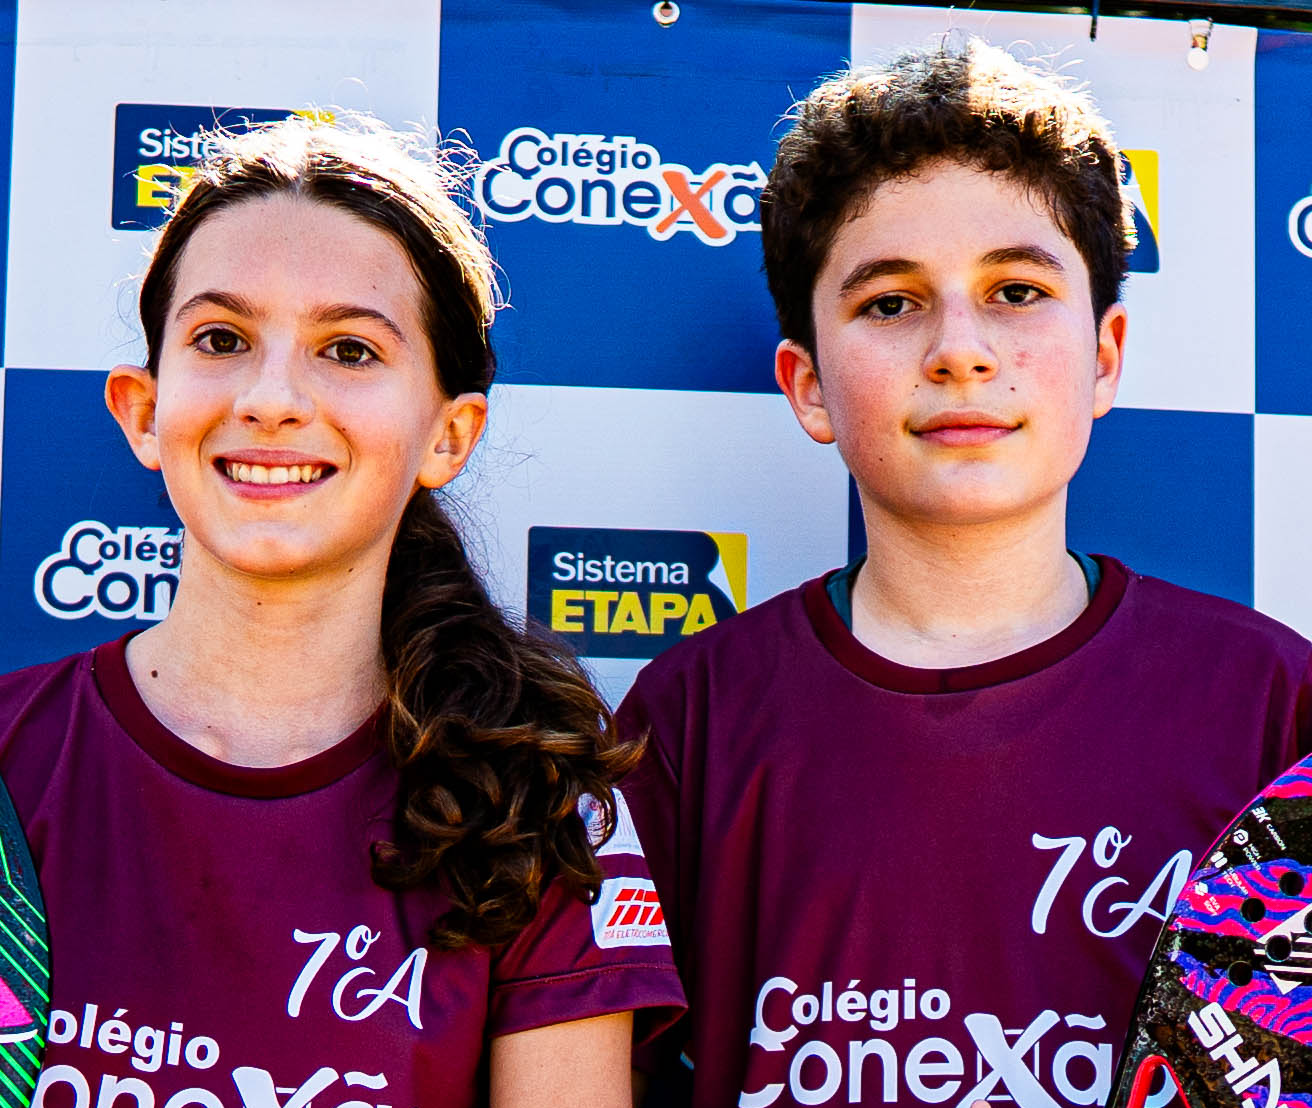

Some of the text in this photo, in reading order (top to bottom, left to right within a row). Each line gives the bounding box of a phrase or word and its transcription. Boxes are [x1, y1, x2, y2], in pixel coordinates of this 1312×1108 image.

[508, 134, 652, 177] Colégio
[482, 167, 761, 238] ConeXã
[70, 528, 181, 570] Colég
[553, 552, 689, 584] Sistema
[551, 590, 718, 635] ETAPA
[754, 976, 951, 1040] Colégio
[48, 1003, 220, 1072] olégio
